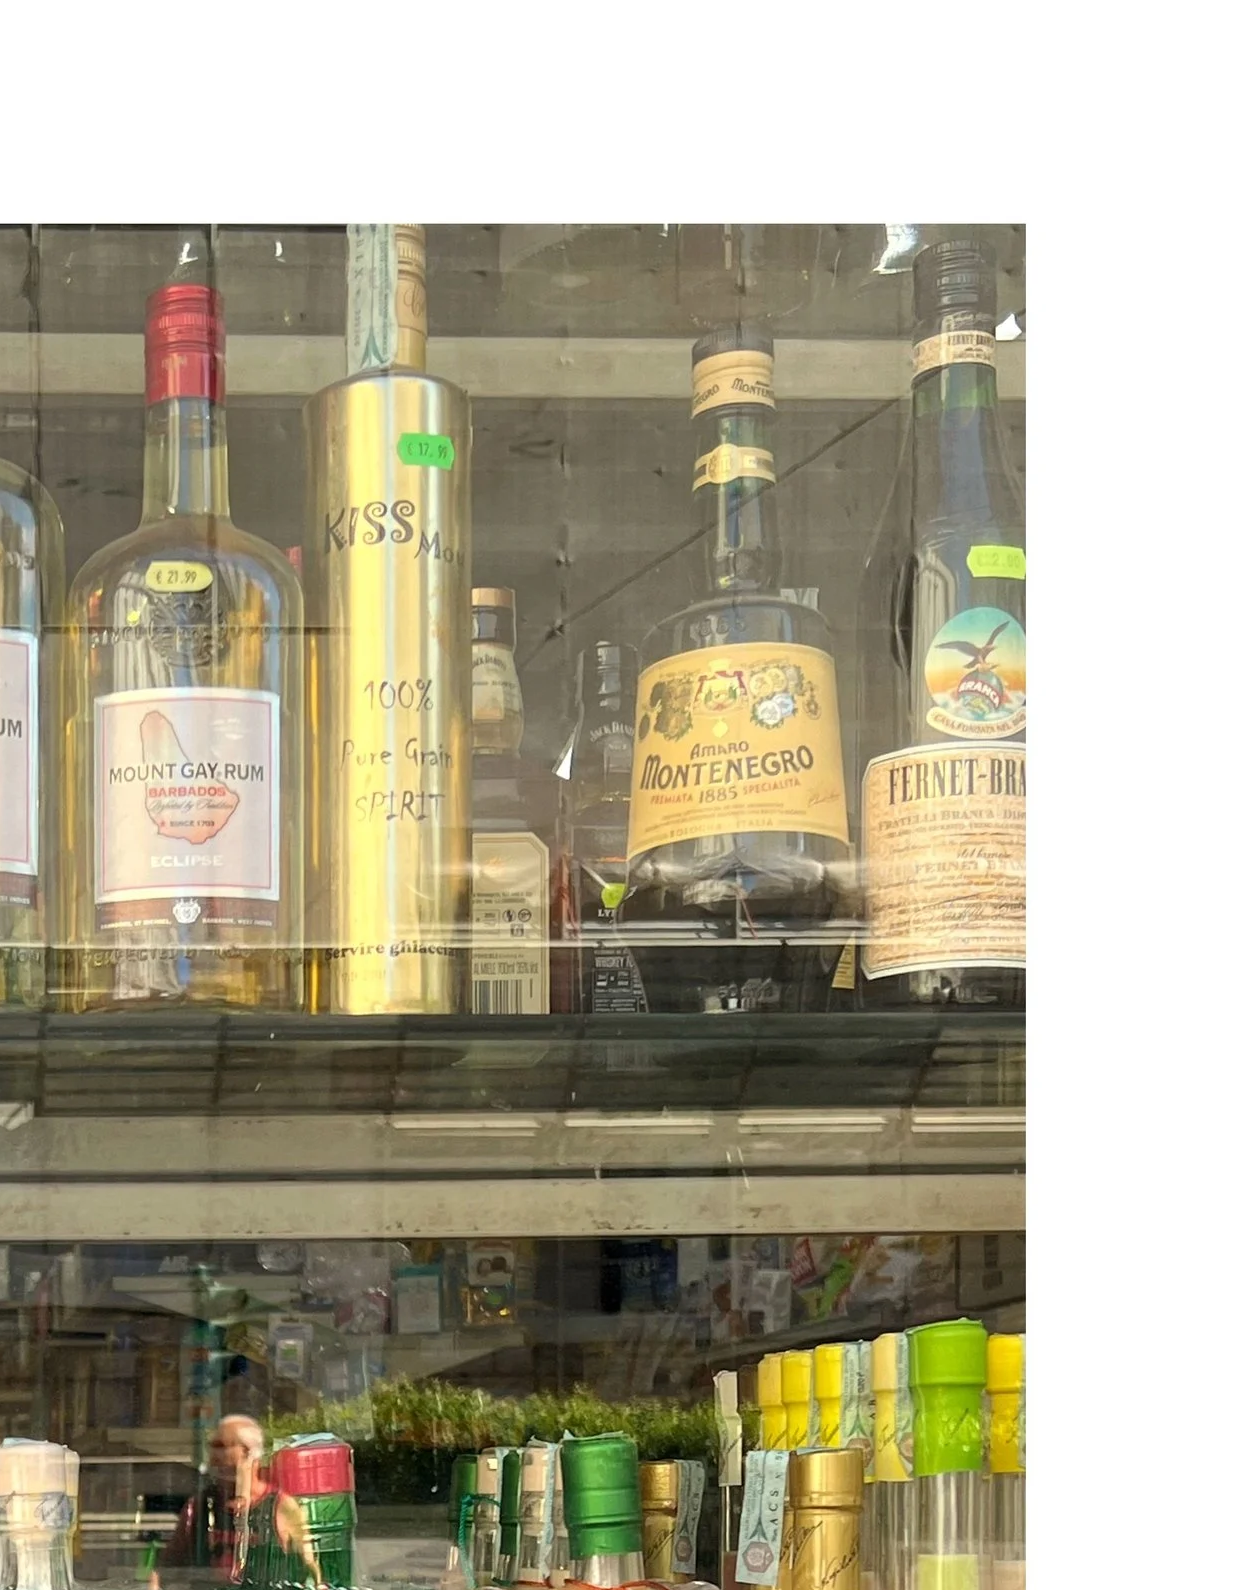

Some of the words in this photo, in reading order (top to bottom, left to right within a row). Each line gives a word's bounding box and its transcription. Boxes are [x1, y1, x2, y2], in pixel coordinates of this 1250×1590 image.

[325, 500, 415, 554] KISS
[167, 571, 197, 584] 21.99
[364, 678, 434, 711] 100%
[959, 680, 1000, 708] BRANCA
[341, 739, 392, 772] Pure
[406, 737, 454, 769] Grain
[690, 741, 749, 760] AMARO
[110, 763, 177, 784] MOUNT
[180, 762, 217, 780] GAY
[223, 764, 265, 782] RUM
[640, 745, 814, 790] MONTENEGRO
[148, 786, 226, 799] BARBADOS
[699, 786, 738, 804] 1885
[355, 790, 446, 822] SPIRIT
[151, 855, 224, 868] ECLIPSE
[325, 944, 385, 961] Servire
